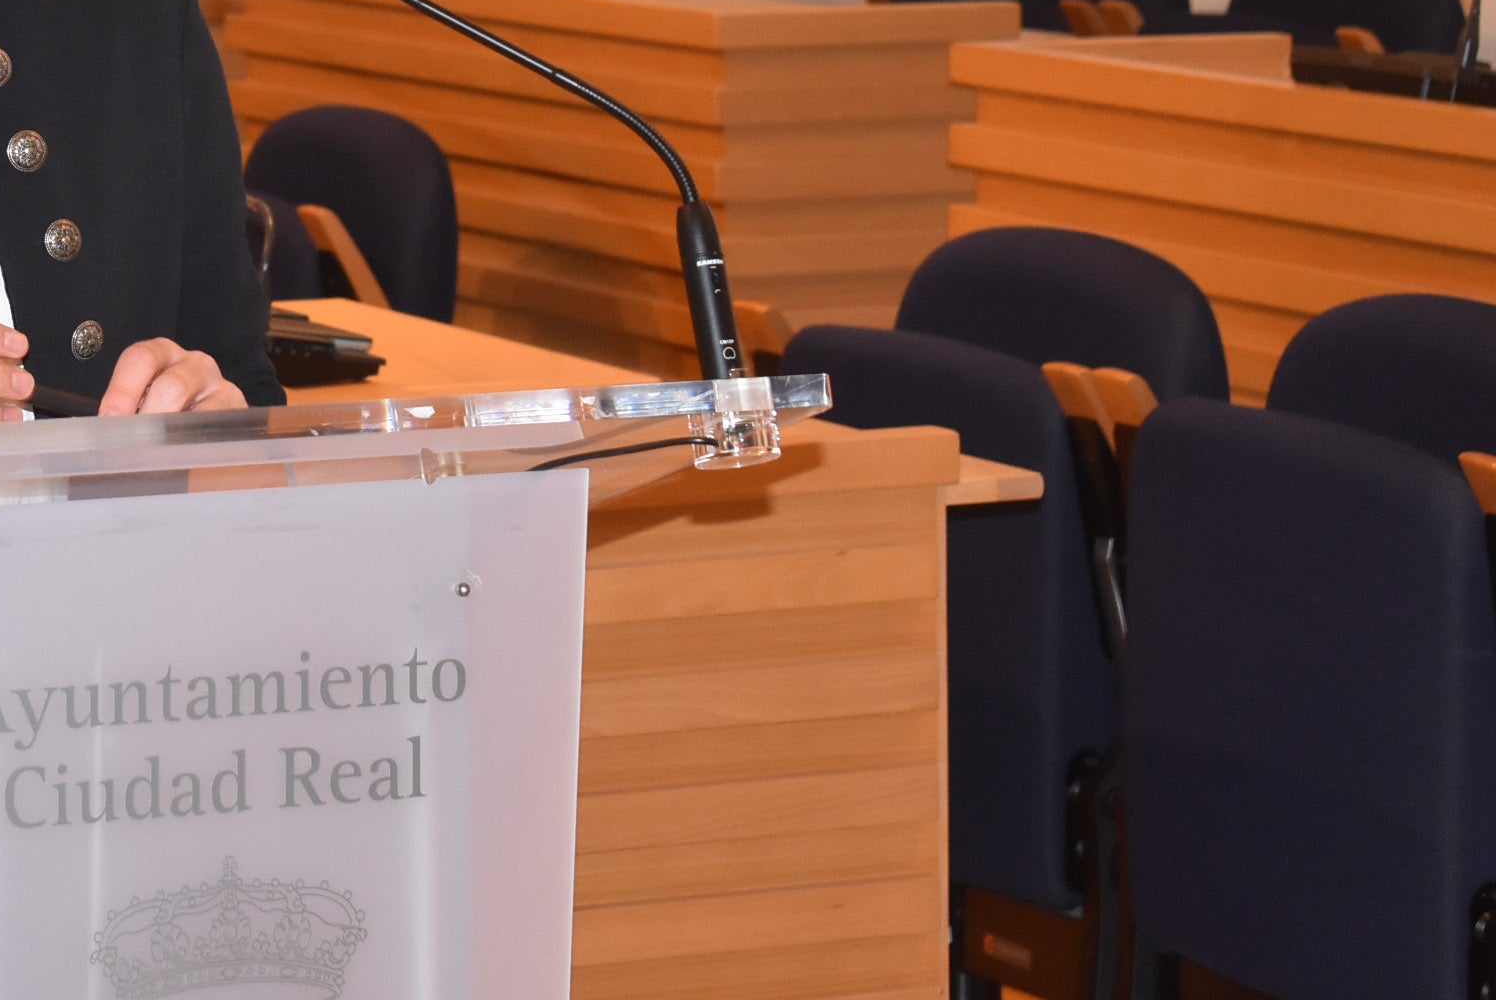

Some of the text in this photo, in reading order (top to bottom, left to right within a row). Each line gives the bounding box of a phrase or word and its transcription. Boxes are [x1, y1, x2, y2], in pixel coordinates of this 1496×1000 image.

[696, 258, 724, 267] SAMSON
[4, 735, 426, 829] Ciudad Real
